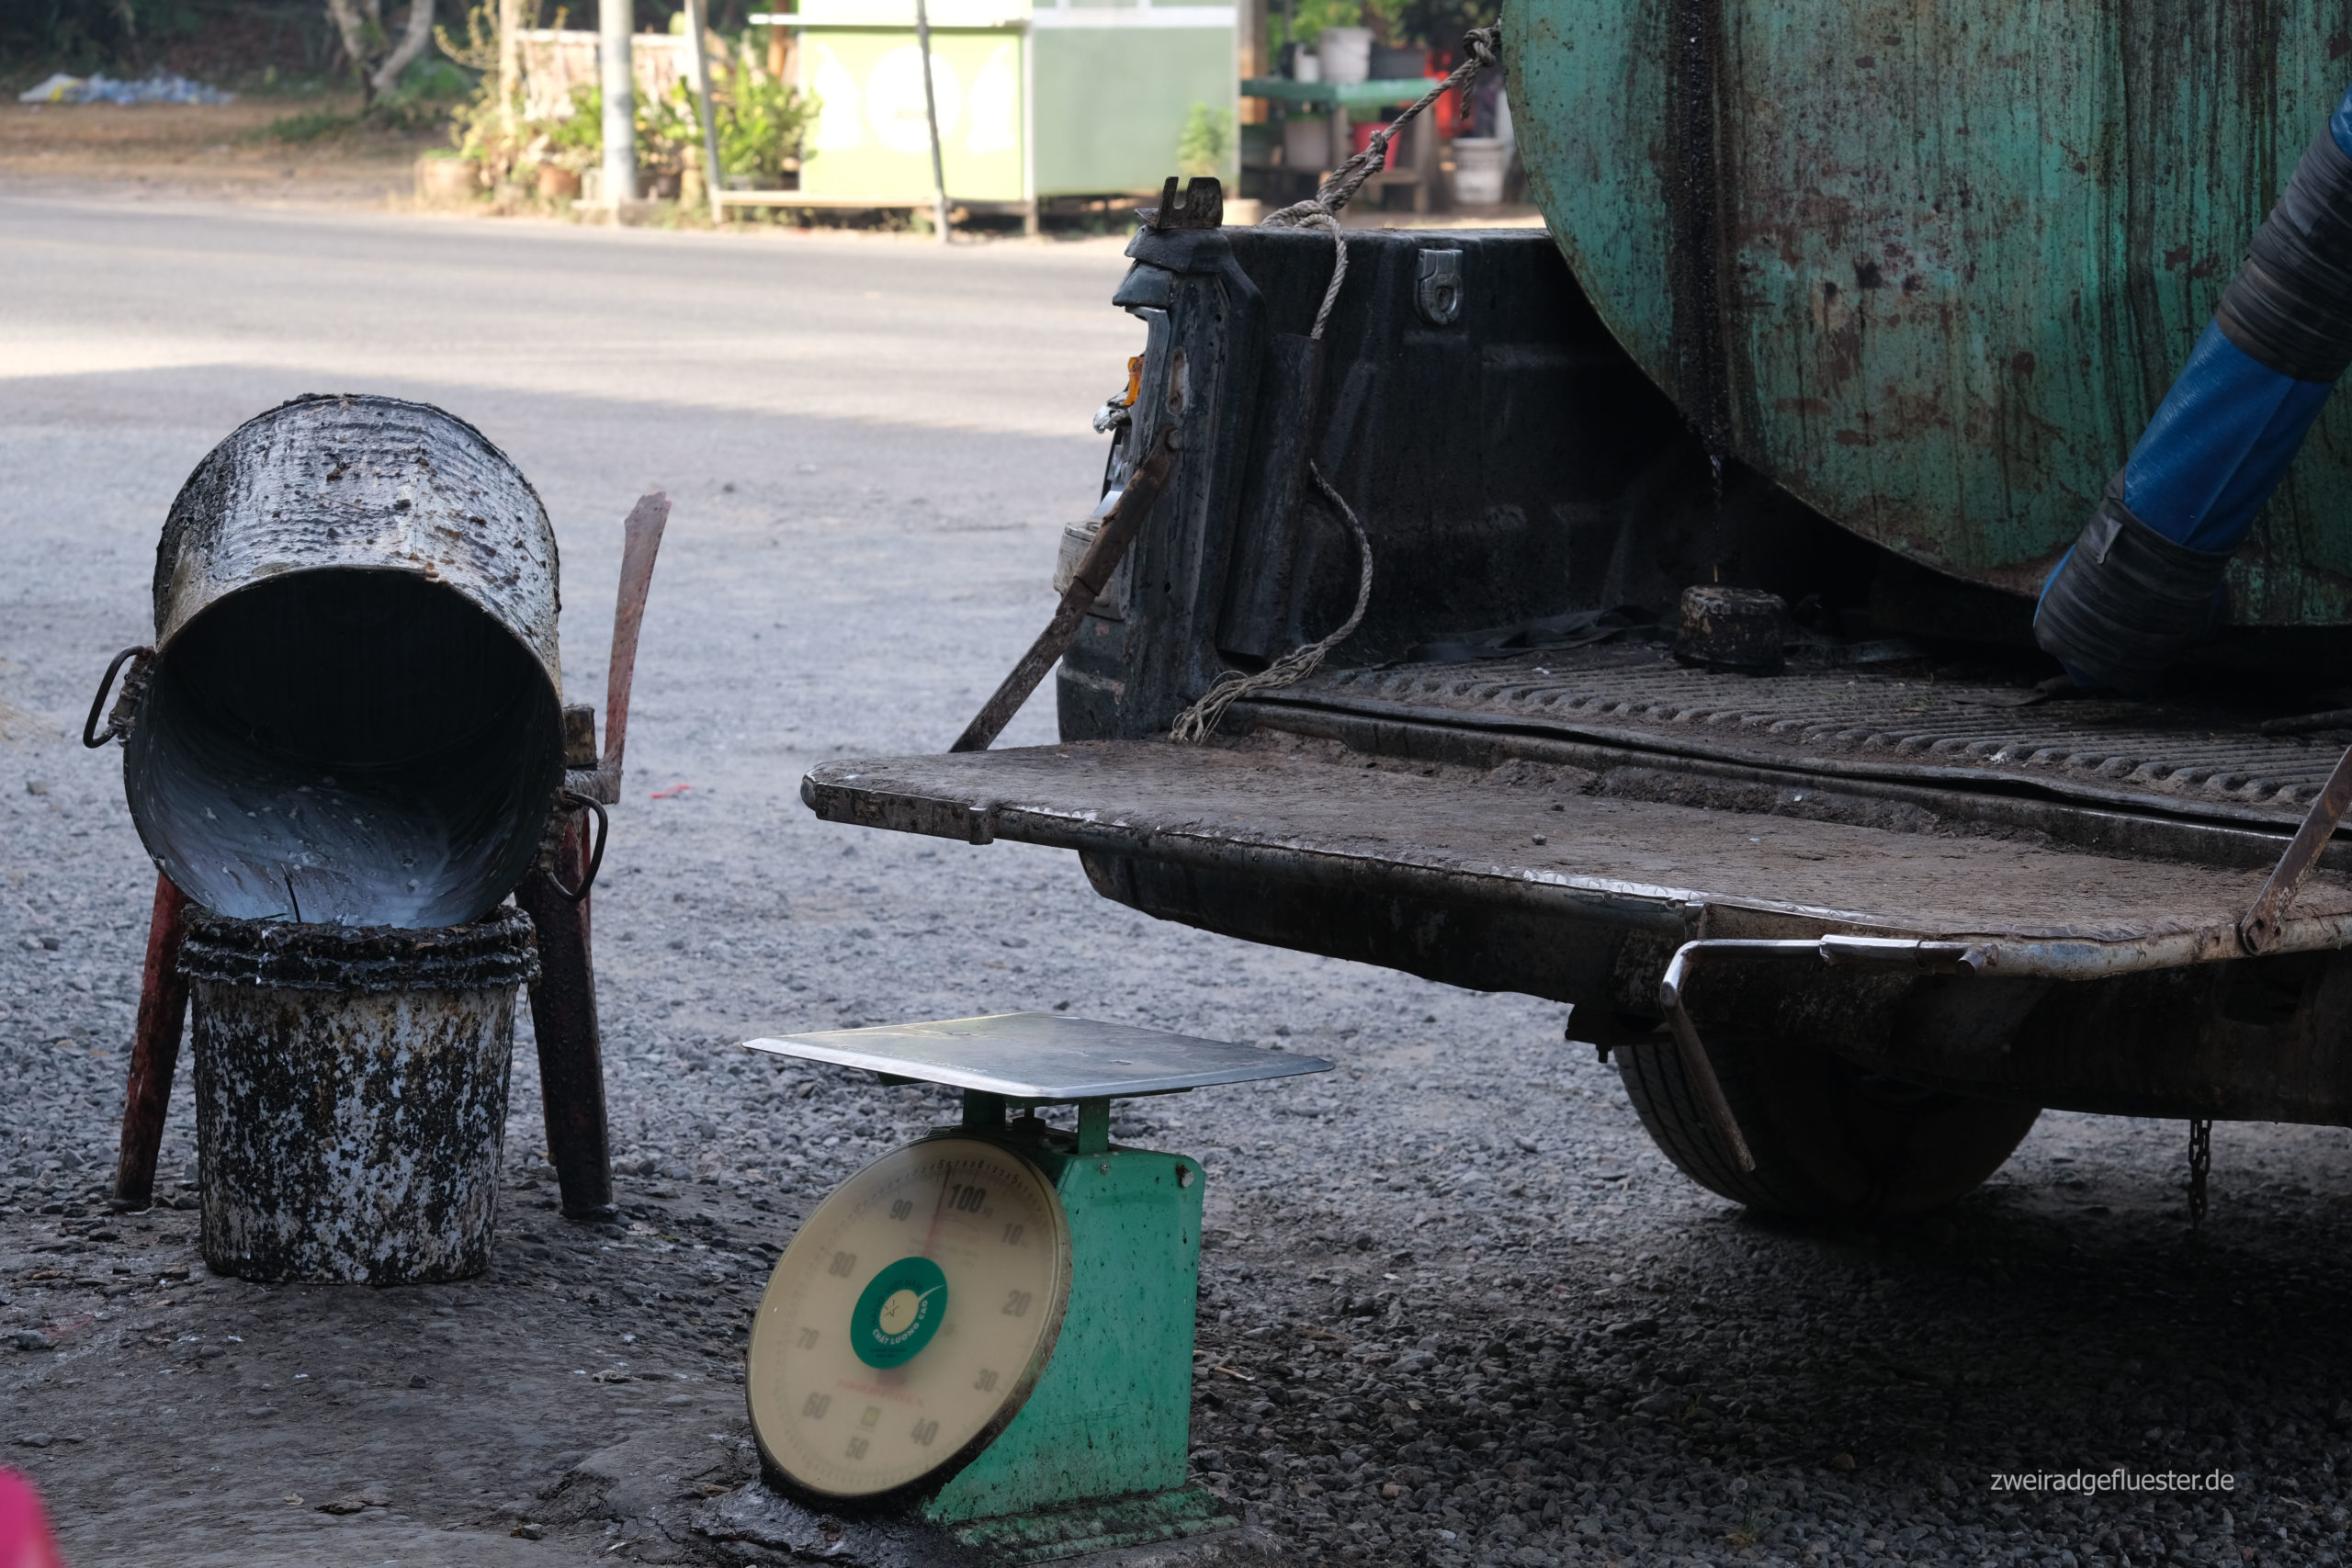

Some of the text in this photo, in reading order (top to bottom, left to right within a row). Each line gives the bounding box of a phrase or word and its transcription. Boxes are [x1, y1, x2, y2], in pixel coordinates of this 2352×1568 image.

[889, 1199, 913, 1222] 90
[948, 1183, 987, 1213] 100
[1001, 1222, 1024, 1246] 10
[829, 1250, 856, 1279] 80
[919, 1300, 928, 1321] CAO
[1001, 1289, 1032, 1318] 20
[797, 1327, 820, 1351] 70
[974, 1369, 1000, 1393] 30
[803, 1393, 831, 1421] 60
[911, 1417, 939, 1447] 40
[845, 1436, 869, 1461] 50
